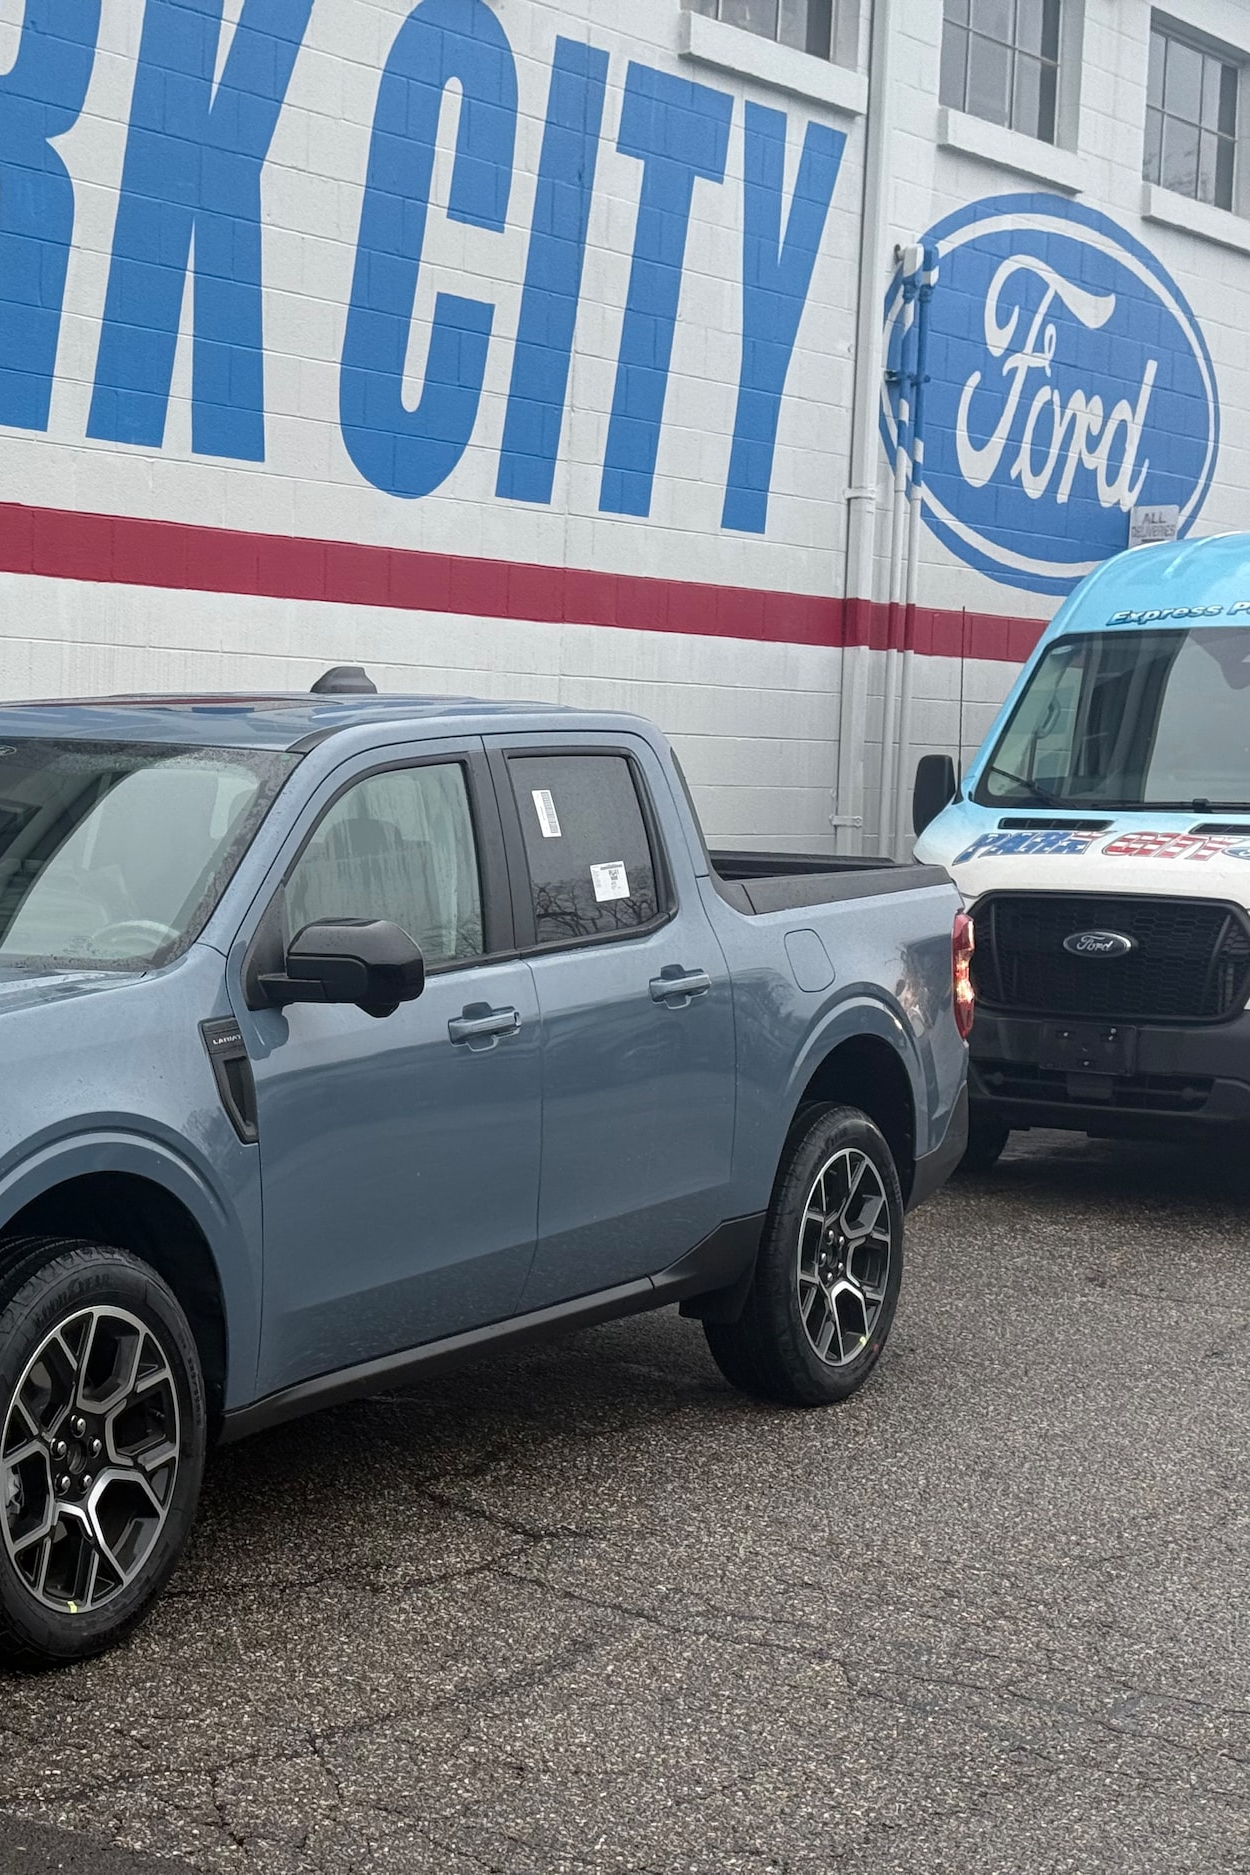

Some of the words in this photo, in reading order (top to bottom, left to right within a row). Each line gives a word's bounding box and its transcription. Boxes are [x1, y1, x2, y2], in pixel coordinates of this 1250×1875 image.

[338, 0, 847, 535] CITY
[956, 254, 1157, 512] Ford
[1141, 511, 1166, 525] ALL
[1106, 606, 1223, 626] Express
[952, 830, 1118, 866] PARK
[1102, 831, 1247, 861] CITY
[1076, 935, 1114, 952] Ford
